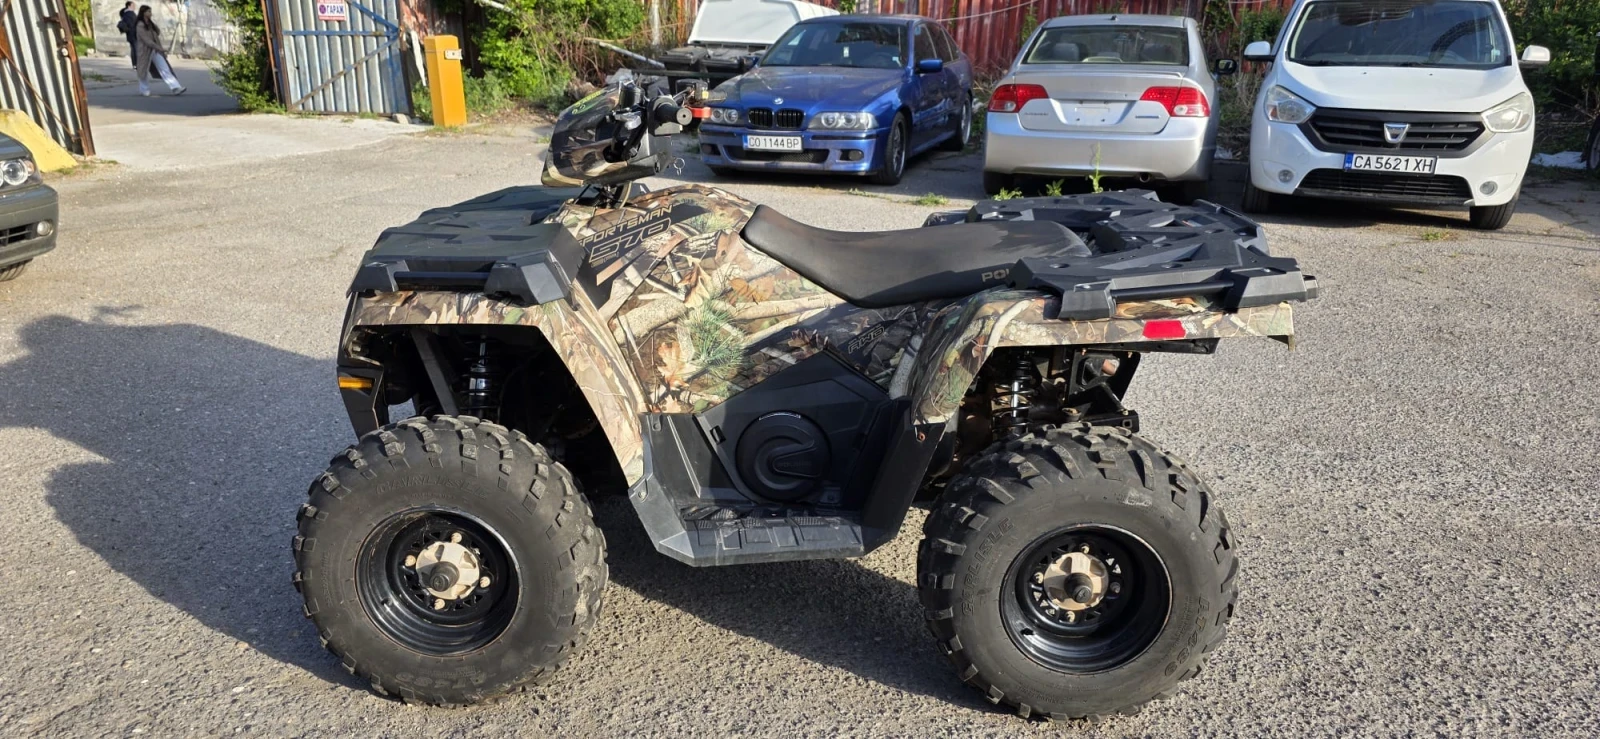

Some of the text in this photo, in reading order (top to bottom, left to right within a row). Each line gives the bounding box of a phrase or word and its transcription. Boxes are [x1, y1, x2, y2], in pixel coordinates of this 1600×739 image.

[763, 137, 785, 148] 1144
[1374, 156, 1410, 171] 5621
[578, 204, 674, 247] PORTSMAN
[588, 217, 672, 264] 570
[961, 518, 1014, 616] CARLISLE
